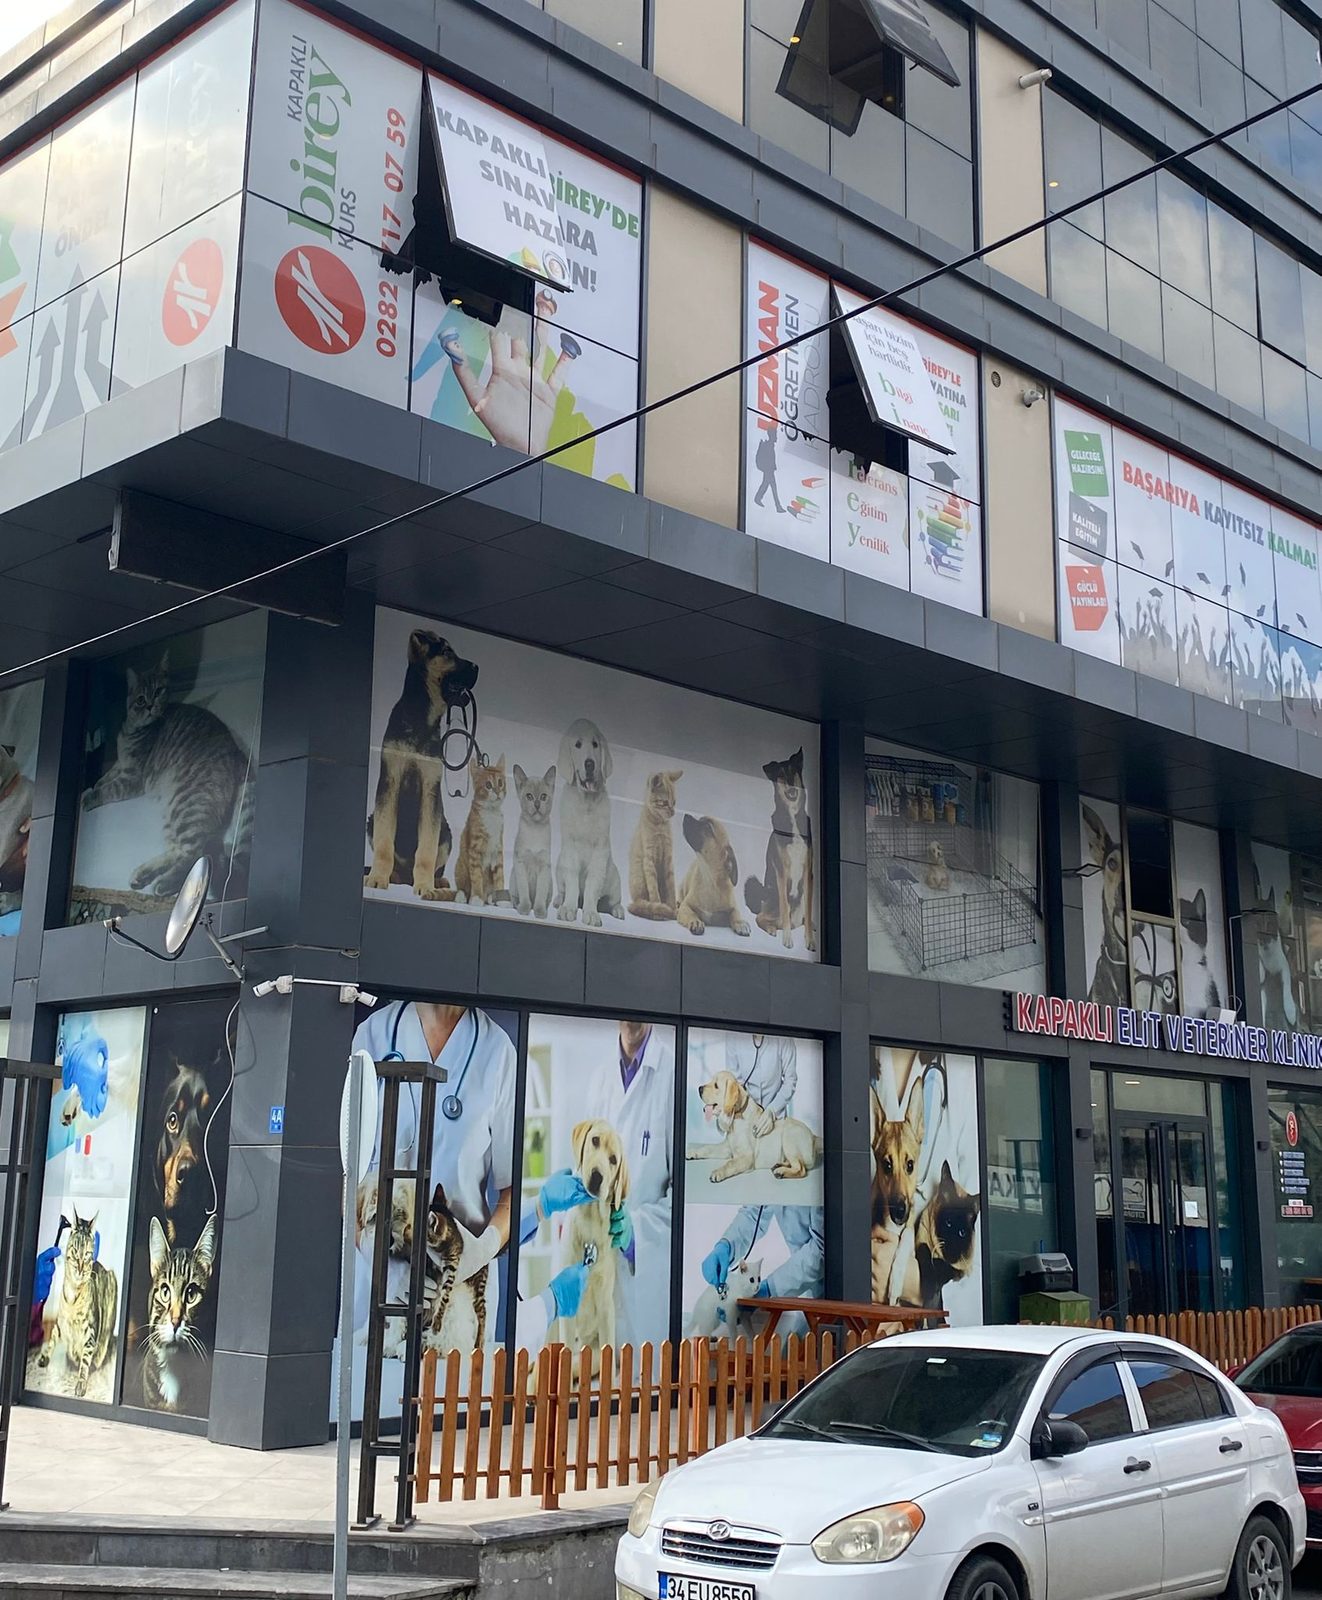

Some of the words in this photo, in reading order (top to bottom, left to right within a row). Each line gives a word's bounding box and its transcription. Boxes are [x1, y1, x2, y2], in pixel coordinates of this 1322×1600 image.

[287, 34, 309, 122] KAPAKLI
[286, 44, 352, 243] birey
[387, 108, 406, 148] 59
[384, 151, 404, 193] 07
[436, 106, 546, 179] KAPAKLI
[549, 170, 639, 238] İREY'DE
[337, 188, 357, 251] KURS
[376, 280, 399, 358] 0282
[757, 280, 779, 431] UZMAN
[781, 293, 799, 442] ÖĞRETMEN
[930, 379, 967, 408] YATINA
[847, 492, 888, 523] eğitim
[847, 521, 890, 555] yenilik
[1123, 461, 1200, 516] BAŞARIYA
[1204, 500, 1264, 546] KAYITSIZ
[1267, 531, 1317, 570] KALMA!
[1017, 992, 1112, 1043] KAPAKLI
[1117, 1007, 1161, 1049] ELİT
[1166, 1014, 1270, 1063] VETERİNER
